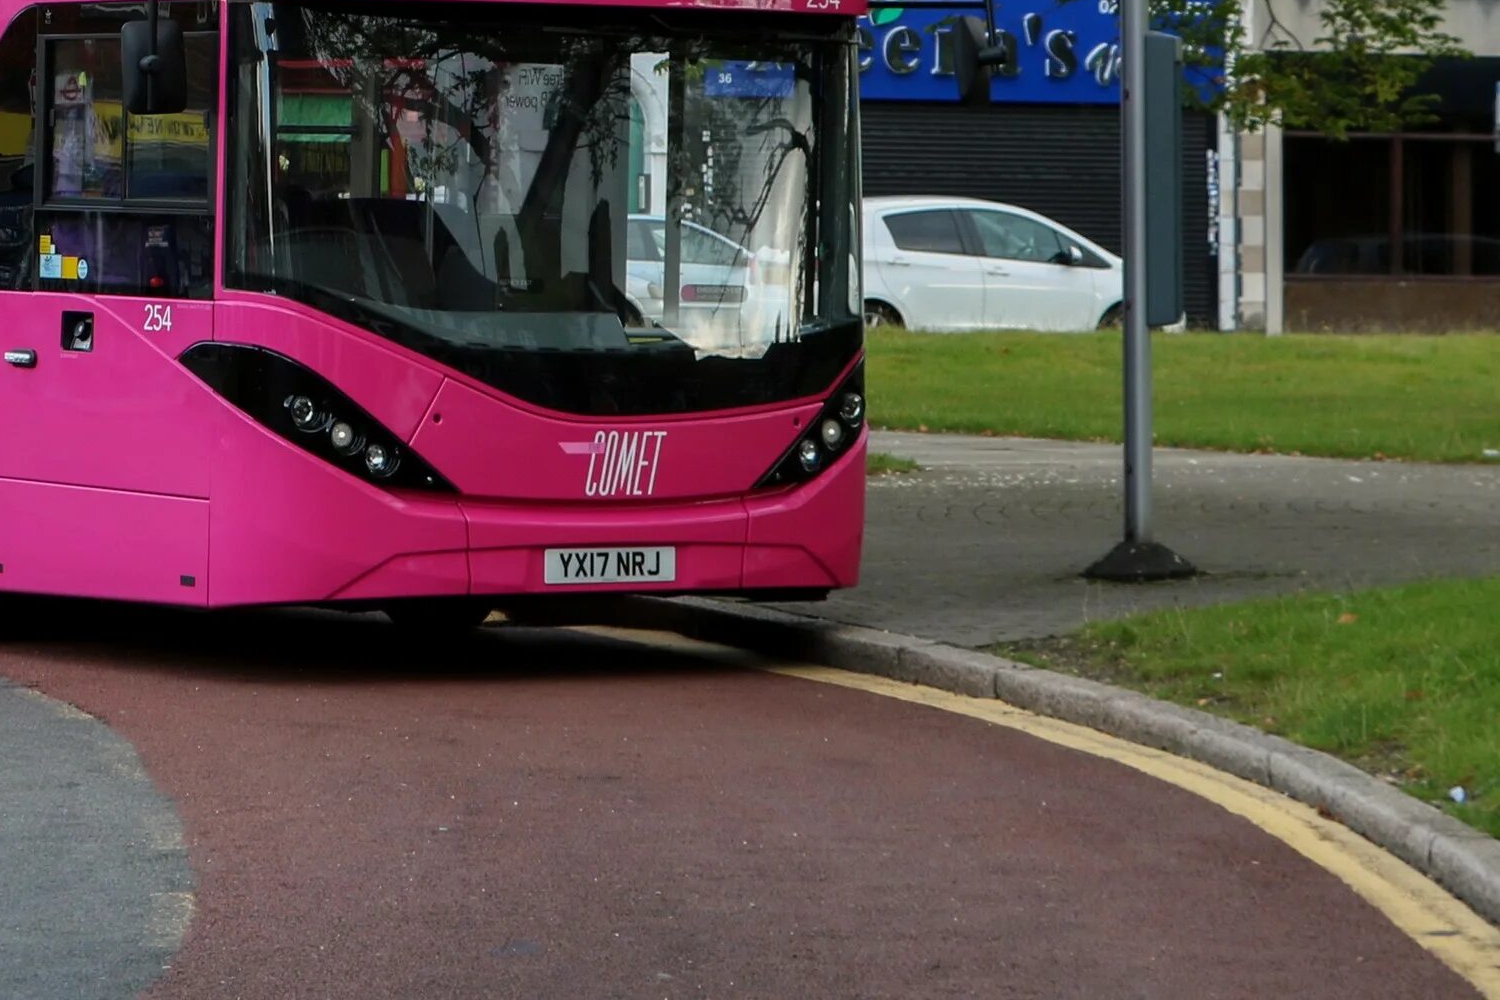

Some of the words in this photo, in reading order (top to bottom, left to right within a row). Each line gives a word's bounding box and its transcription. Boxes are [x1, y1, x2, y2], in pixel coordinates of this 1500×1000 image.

[718, 73, 733, 84] 36
[143, 304, 172, 332] 254
[585, 430, 668, 496] COMET
[559, 552, 610, 577] YX17
[617, 551, 660, 576] NRJ
